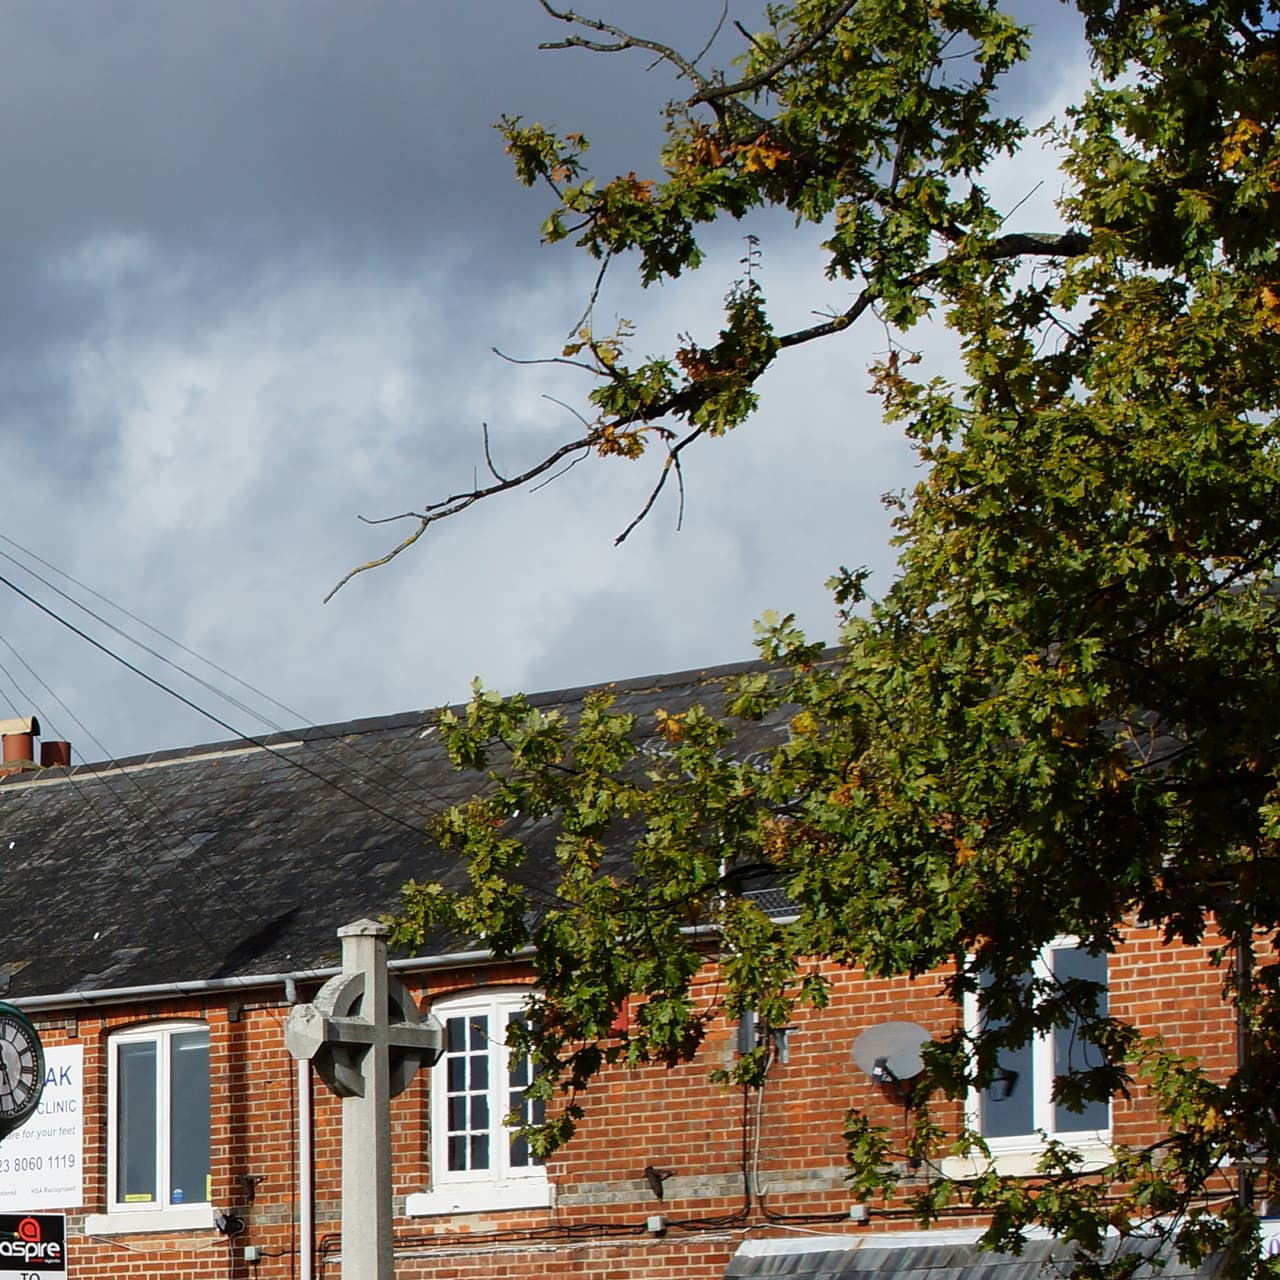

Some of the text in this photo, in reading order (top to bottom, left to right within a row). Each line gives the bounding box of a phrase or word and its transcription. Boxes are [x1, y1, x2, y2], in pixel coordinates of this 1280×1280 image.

[43, 1065, 72, 1087] AK
[37, 1099, 77, 1114] CLINIC
[6, 1125, 76, 1142] are for your feet
[14, 1156, 43, 1172] 8060
[48, 1153, 76, 1169] 1119
